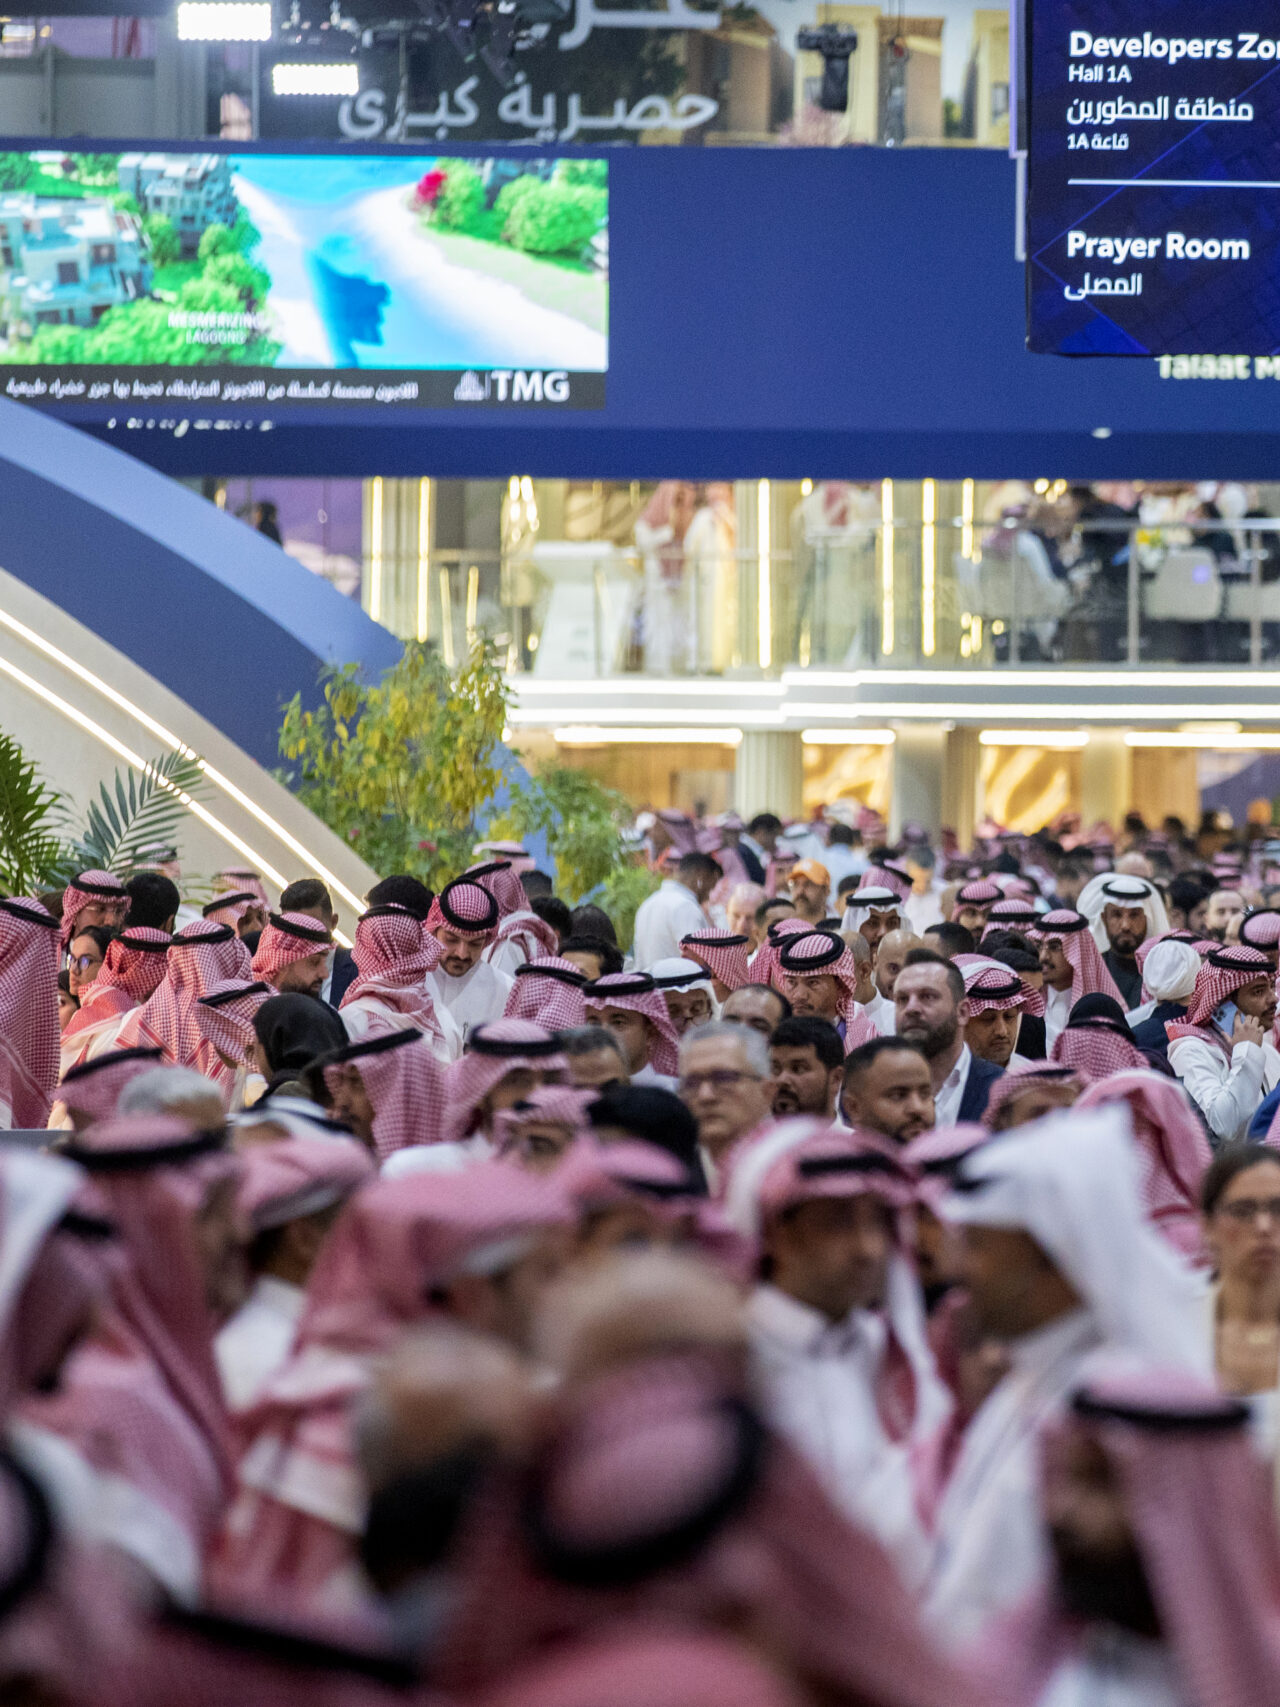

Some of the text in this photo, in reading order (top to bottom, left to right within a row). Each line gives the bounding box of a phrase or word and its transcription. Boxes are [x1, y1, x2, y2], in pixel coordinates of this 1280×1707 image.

[1069, 31, 1233, 64] Developers
[1068, 64, 1132, 83] Hall 1A
[1066, 96, 1254, 125] منطقة المطورين
[1067, 133, 1130, 151] قاعة 1A
[1067, 230, 1250, 264] Prayer Room
[1063, 272, 1143, 301] المصلى
[1154, 354, 1251, 380] Talaat
[491, 369, 570, 402] TMG
